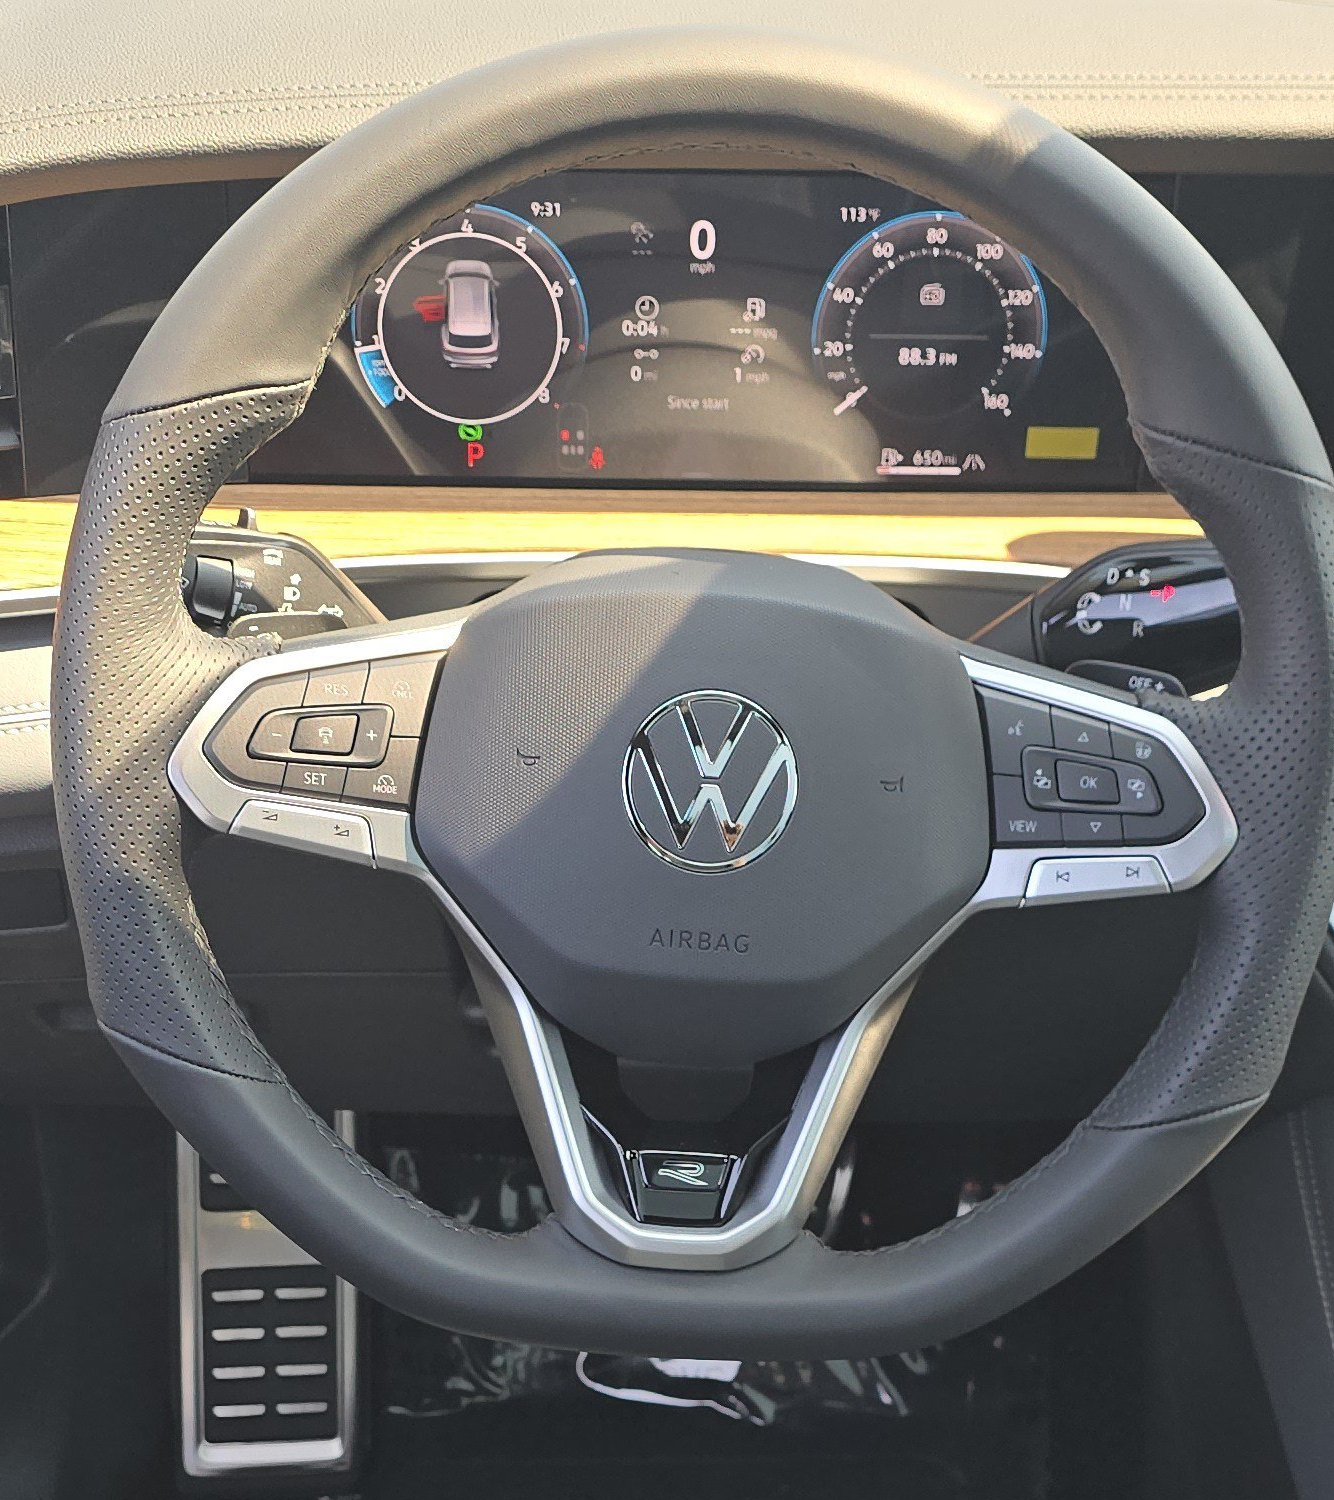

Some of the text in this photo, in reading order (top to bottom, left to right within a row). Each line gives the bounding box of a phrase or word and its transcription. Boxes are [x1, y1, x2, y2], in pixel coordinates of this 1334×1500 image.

[530, 201, 561, 217] 9:31
[516, 236, 526, 252] 5
[689, 219, 716, 260] 0
[926, 227, 948, 244] 80
[872, 241, 895, 259] 60
[975, 243, 1004, 260] 100
[689, 261, 716, 276] mph
[374, 278, 386, 294] 2
[553, 280, 564, 298] 6
[832, 287, 854, 303] 40
[1007, 289, 1033, 306] 120
[621, 319, 658, 337] 0:04
[823, 340, 844, 357] 20
[898, 347, 937, 366] 88.3
[1010, 343, 1036, 360] 140
[630, 365, 642, 382] 0
[733, 366, 742, 384] 1
[667, 394, 730, 411] Since start
[467, 442, 485, 468] P
[1106, 567, 1151, 586] D S
[1119, 593, 1133, 612] N
[1132, 620, 1144, 639] R
[324, 683, 349, 696] RES
[1128, 675, 1154, 690] OFF
[303, 771, 328, 786] SET
[1079, 777, 1098, 790] OK
[372, 784, 398, 795] MODE
[1008, 819, 1038, 833] VIEW
[649, 927, 751, 953] AIRBAG
